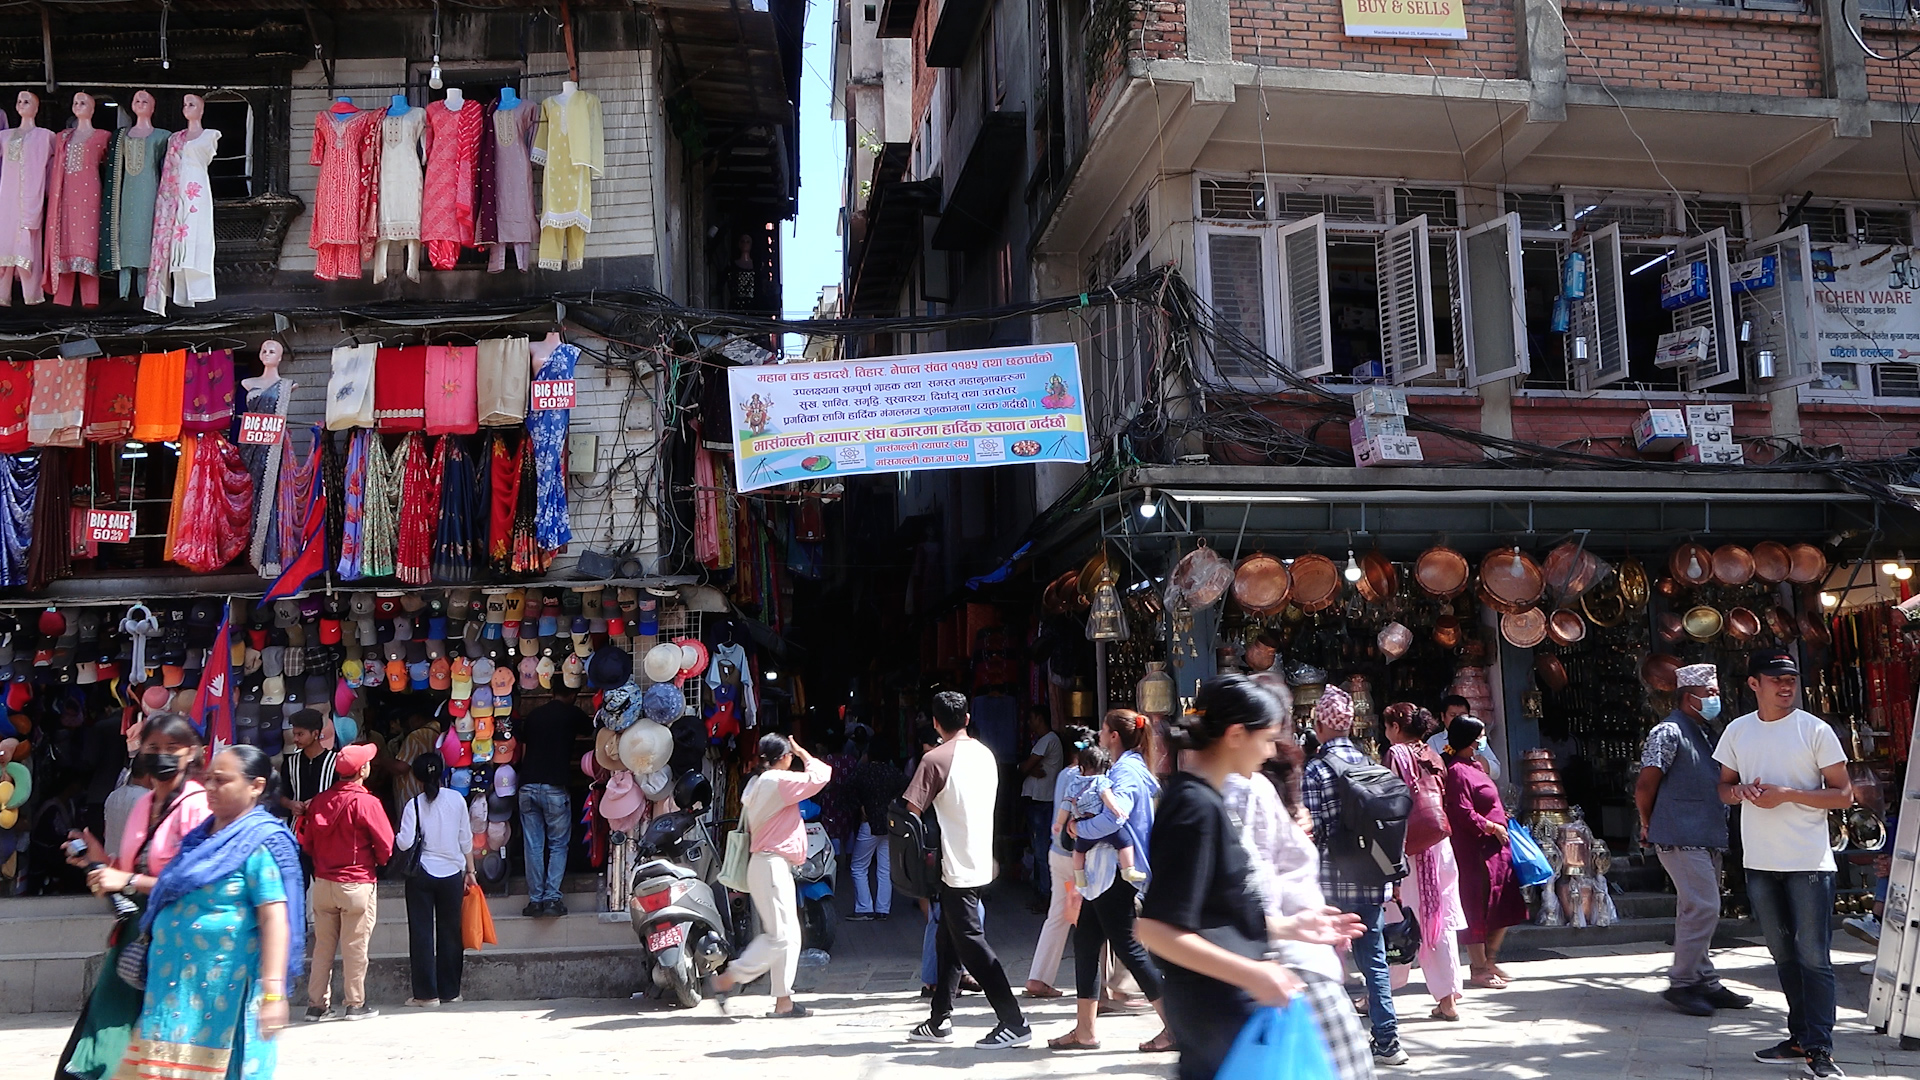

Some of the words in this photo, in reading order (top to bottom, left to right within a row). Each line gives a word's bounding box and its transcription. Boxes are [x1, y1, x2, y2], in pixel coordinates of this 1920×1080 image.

[1358, 0, 1387, 13] BUY
[1392, 0, 1402, 13] &
[1407, 1, 1450, 16] SELLS
[1869, 291, 1912, 304] WARE
[1829, 345, 1858, 358] पहिलो
[757, 373, 786, 383] महान
[890, 364, 920, 375] नेपाल
[924, 361, 948, 373] संवत
[952, 360, 978, 370] ११४५
[982, 358, 1002, 368] तथा
[1006, 352, 1053, 366] छठपर्वको
[534, 383, 551, 398] BIG
[552, 382, 574, 396] SALE
[904, 380, 921, 389] तथा
[928, 378, 956, 388] समस्त
[961, 390, 979, 398] तथा
[783, 413, 820, 426] प्रगतिका
[822, 410, 845, 422] लागि
[848, 408, 877, 420] हार्दिक
[880, 406, 920, 418] मंगलमय
[924, 404, 970, 416] शुभकामना
[976, 402, 998, 410] व्यक्त
[244, 416, 260, 430] BIG
[261, 416, 283, 432] SALE
[754, 432, 815, 452] मासंगल्ली
[818, 430, 861, 444] व्यापार
[864, 427, 886, 440] संघ
[889, 424, 938, 439] बजारमा
[942, 420, 982, 436] हार्दिक
[986, 420, 1026, 433] स्वागत
[921, 440, 951, 450] व्यापार
[953, 439, 969, 448] संघ
[958, 454, 970, 463] २५
[90, 512, 107, 528] BIG
[108, 514, 130, 530] SALE
